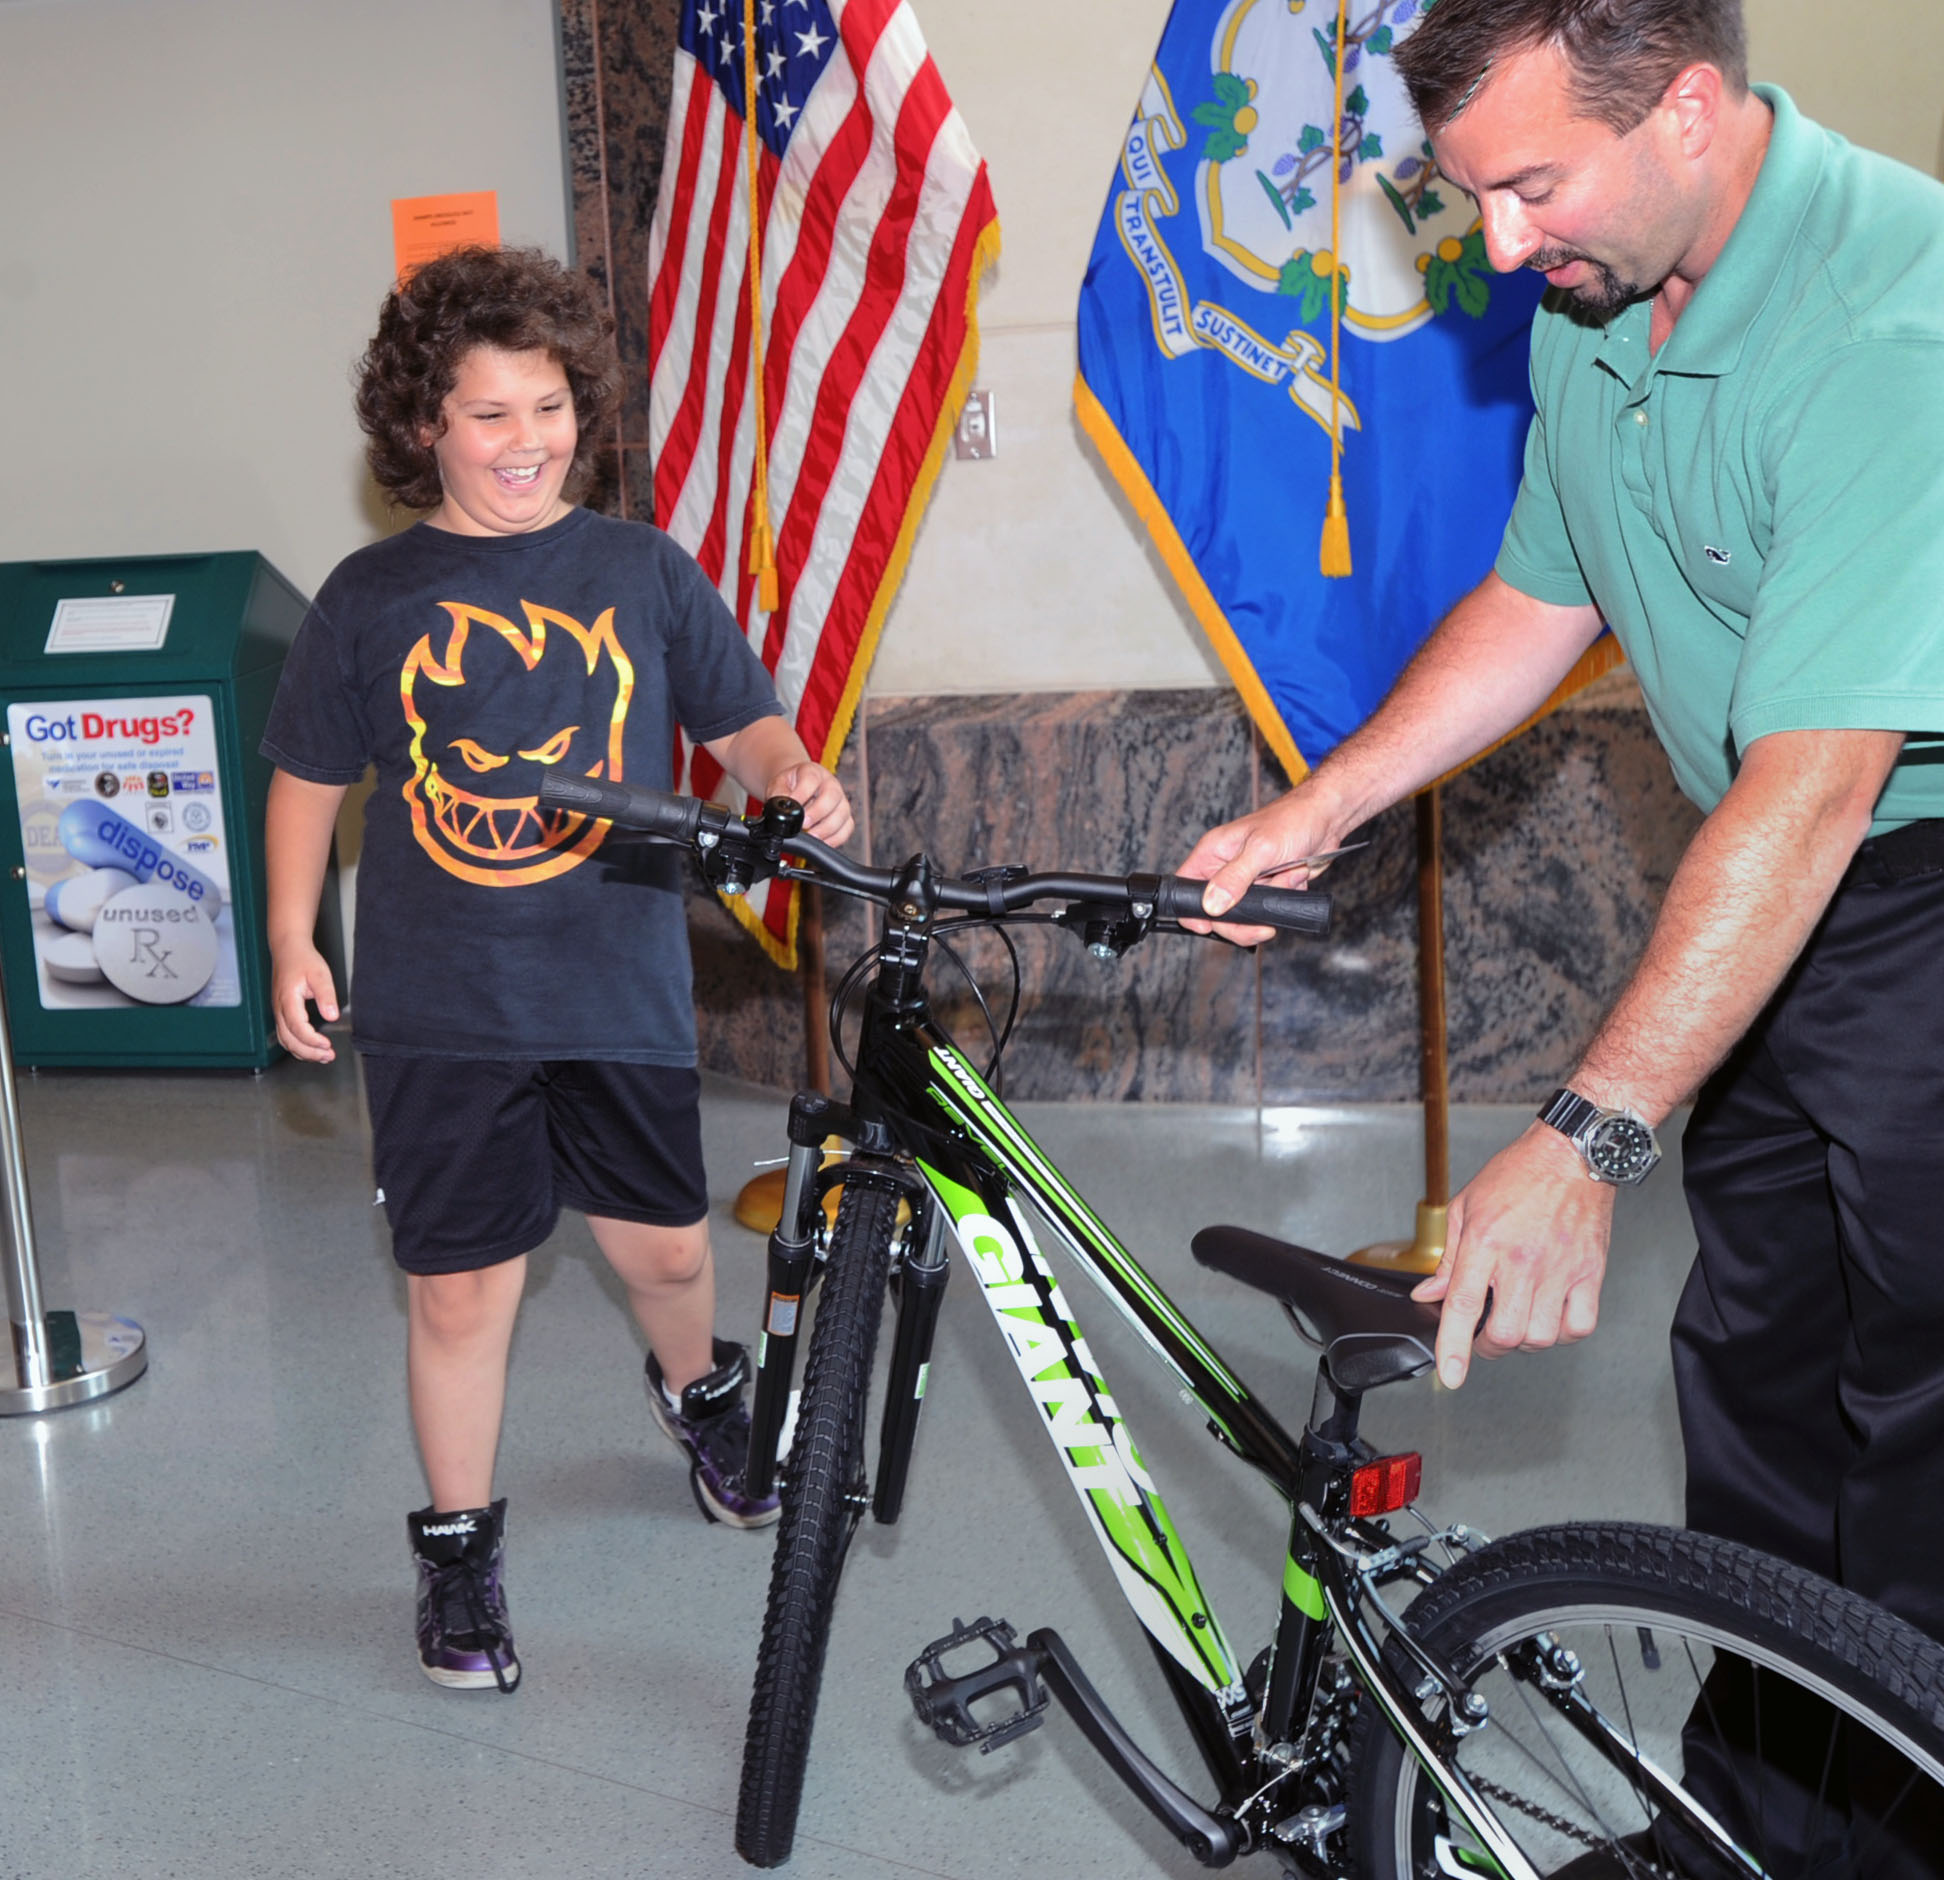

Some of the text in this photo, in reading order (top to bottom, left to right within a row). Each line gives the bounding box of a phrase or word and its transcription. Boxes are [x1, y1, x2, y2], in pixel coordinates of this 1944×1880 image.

[1128, 136, 1151, 181] QUI
[1125, 197, 1184, 336] TRANSTULIT
[1197, 311, 1289, 378] SUSTINET
[25, 708, 195, 744] Got Drugs?
[97, 819, 204, 901] dispose
[103, 905, 199, 924] unused
[933, 1046, 986, 1100] GIANT
[956, 1212, 1142, 1507] GIANT
[423, 1520, 478, 1536] HAWK
